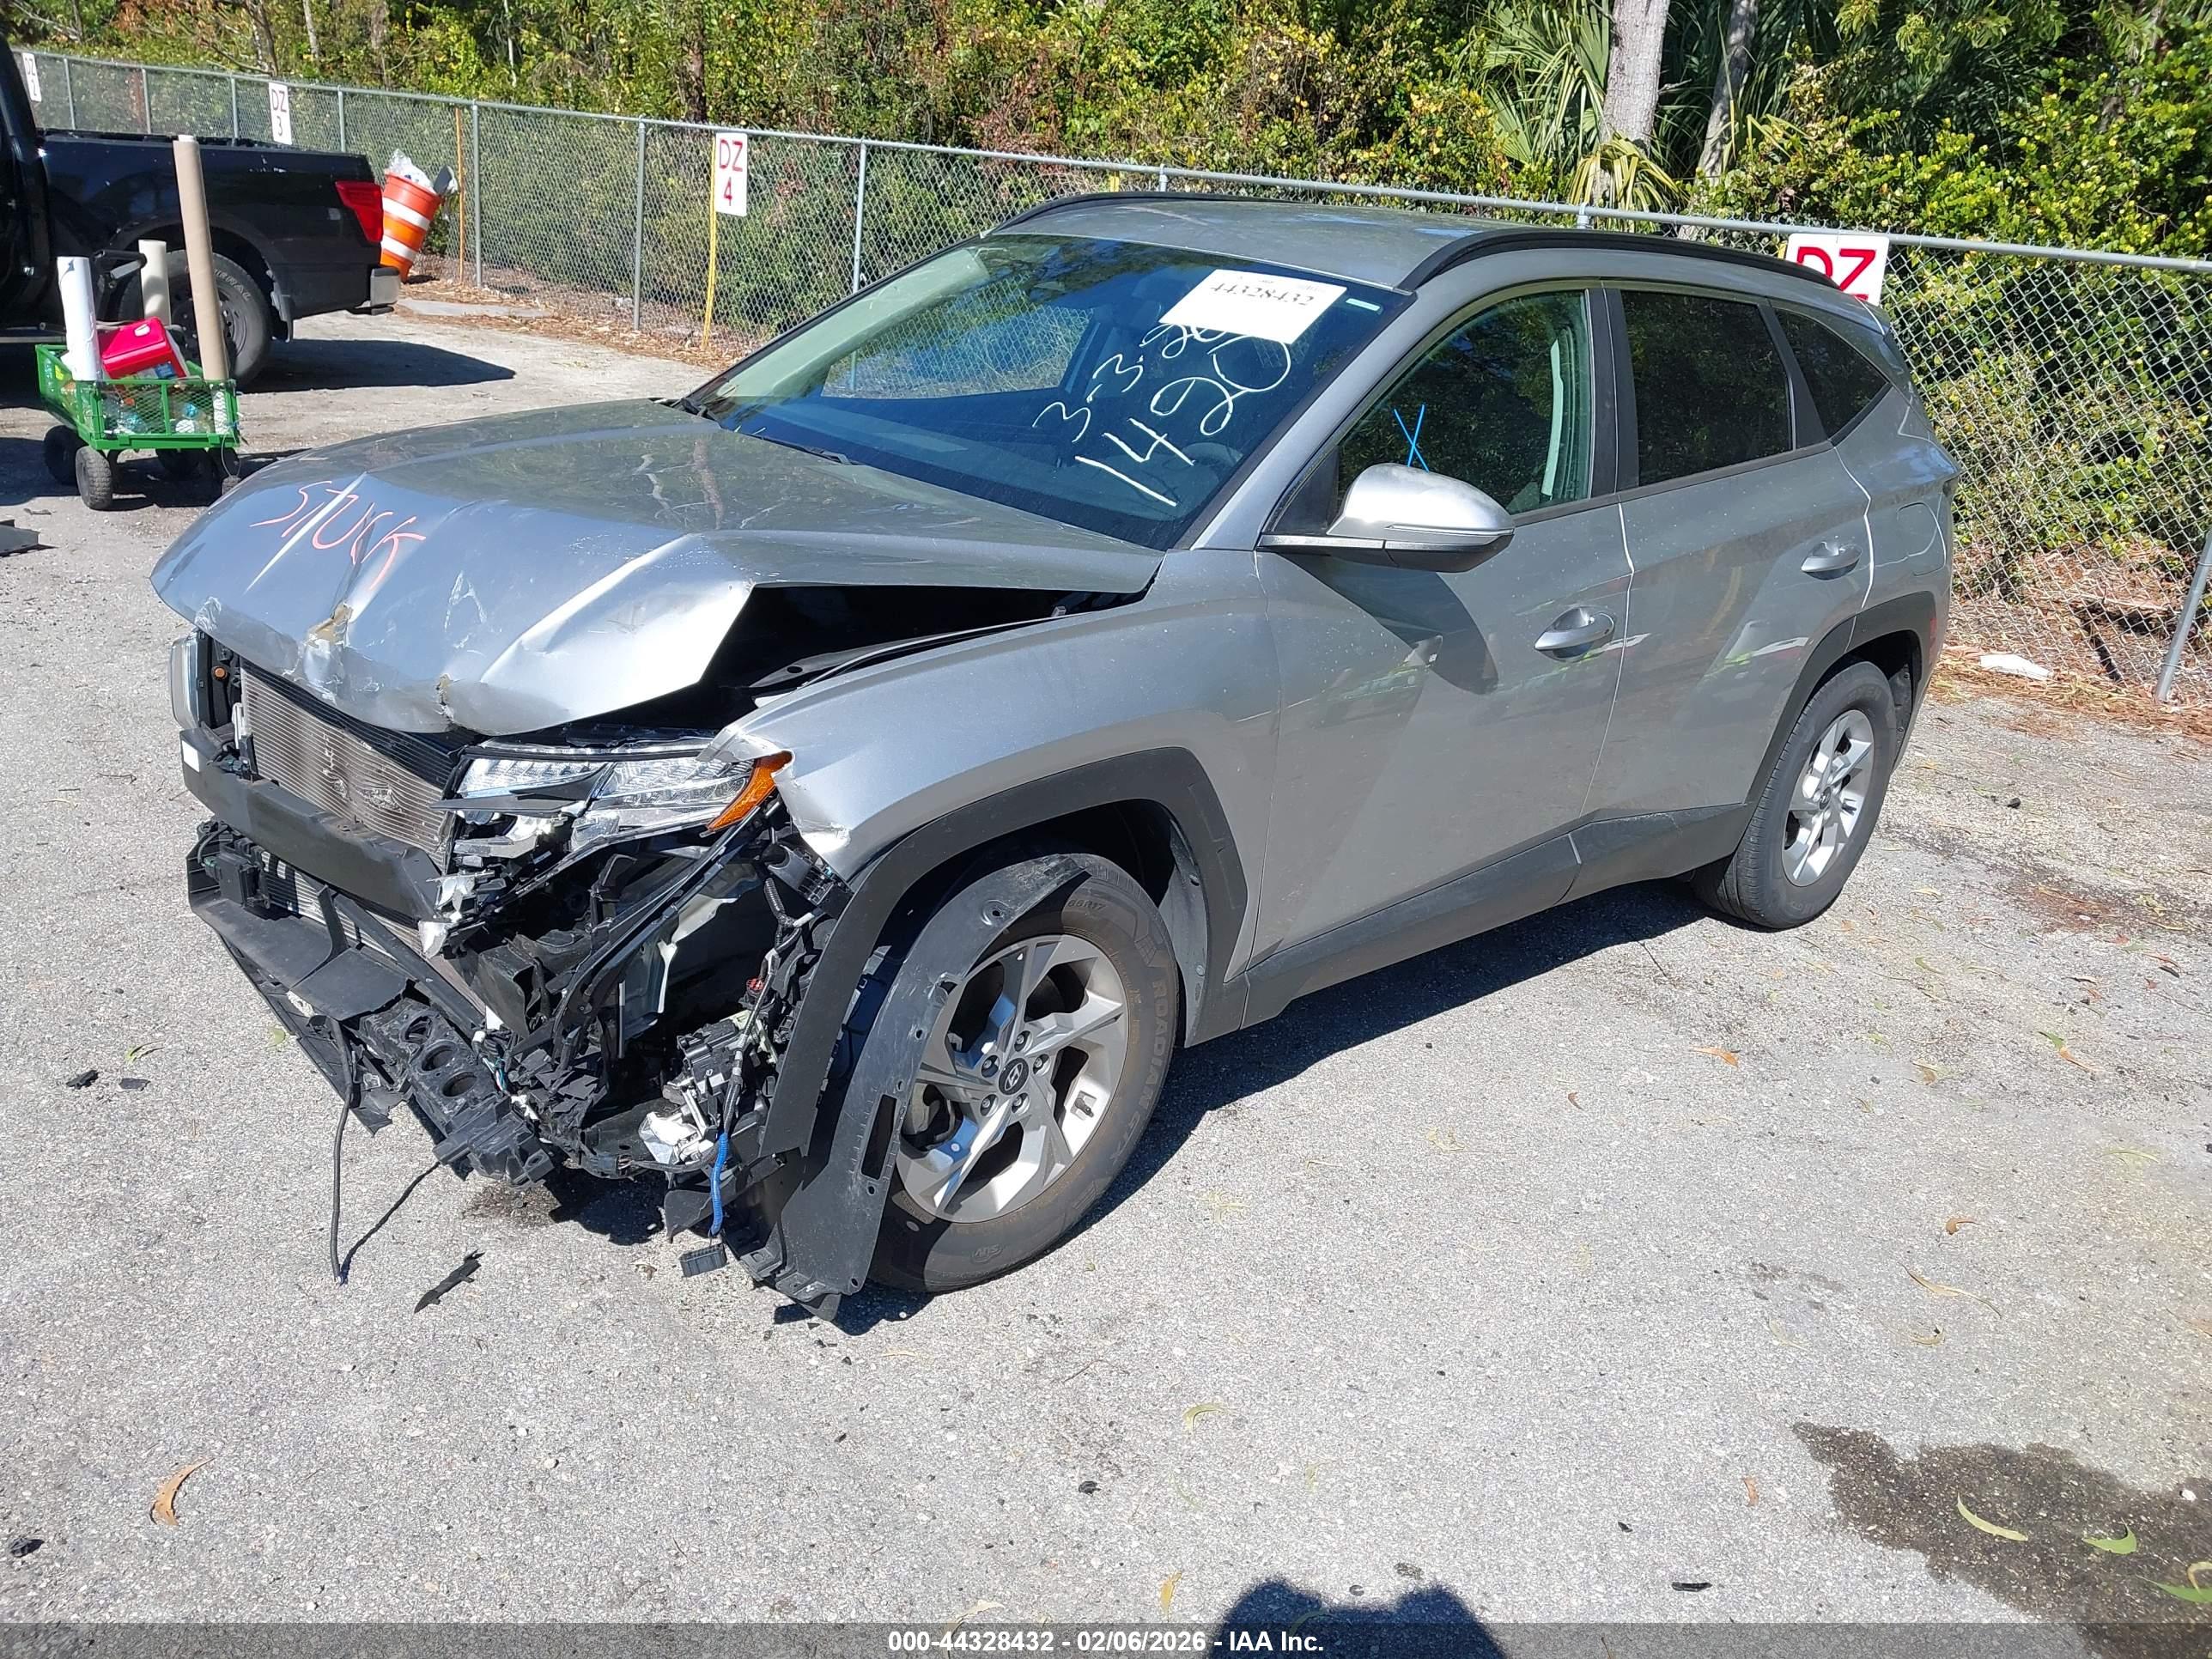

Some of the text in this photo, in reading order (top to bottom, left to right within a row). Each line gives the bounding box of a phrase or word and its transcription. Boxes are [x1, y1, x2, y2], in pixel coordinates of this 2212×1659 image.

[271, 88, 287, 112] DZ
[276, 115, 283, 136] 3
[720, 139, 743, 172] DZ
[724, 176, 732, 206] 4
[1210, 282, 1316, 307] 44328432
[1139, 979, 1169, 1109] ROADIAN
